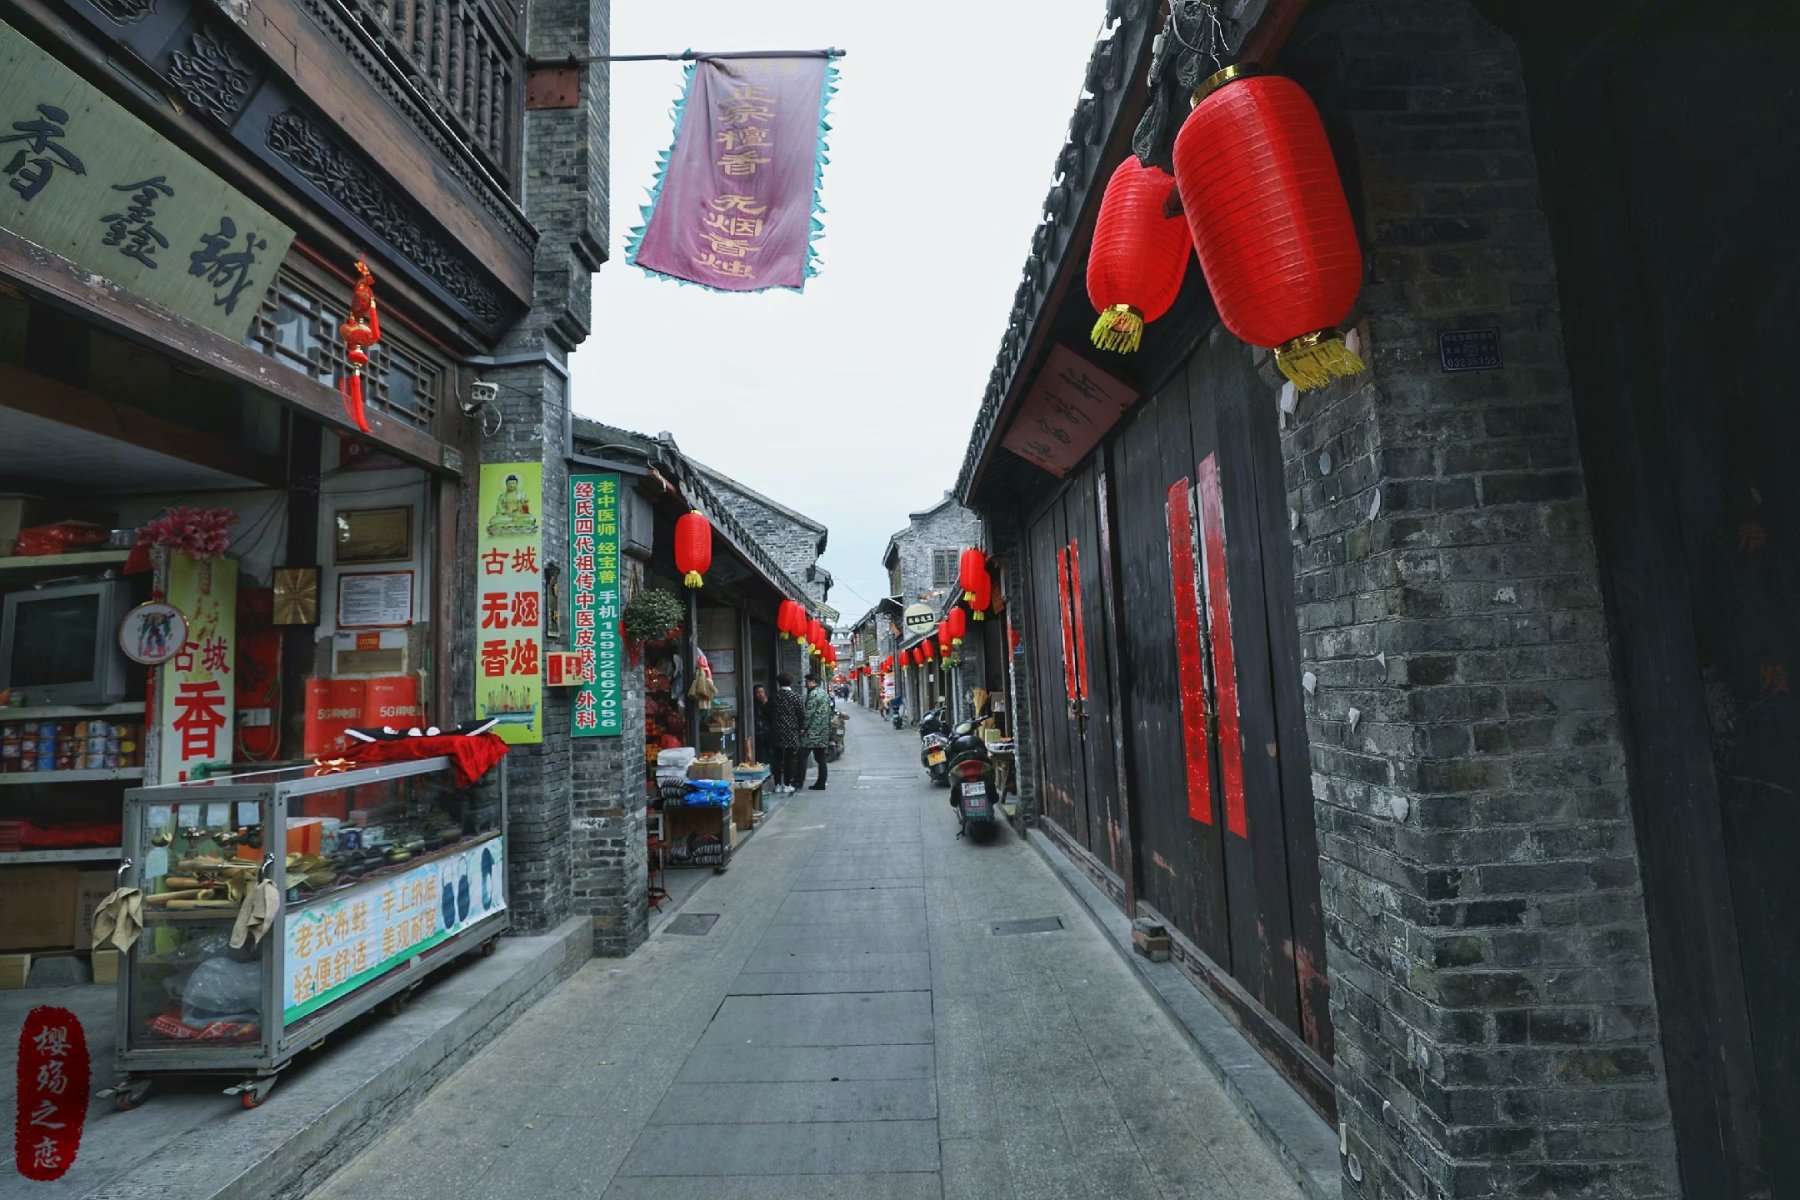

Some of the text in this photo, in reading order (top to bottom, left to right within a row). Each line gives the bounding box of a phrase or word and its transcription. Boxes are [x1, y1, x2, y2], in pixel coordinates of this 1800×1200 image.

[715, 84, 777, 176] 正宗檀香
[693, 195, 767, 279] 无烟香烛
[598, 481, 617, 536] 老中医师
[481, 546, 540, 575] 古城
[598, 542, 617, 584] 经宝善
[481, 591, 540, 629] 无烟
[575, 482, 597, 729] 经氏四代祖传中医皮肤科 外科
[174, 635, 231, 674] 古城
[480, 638, 539, 677] 香烛
[172, 680, 226, 761] 香
[293, 907, 437, 1005] 轻便舒适 美观耐穿
[295, 901, 368, 959] 老式布鞋
